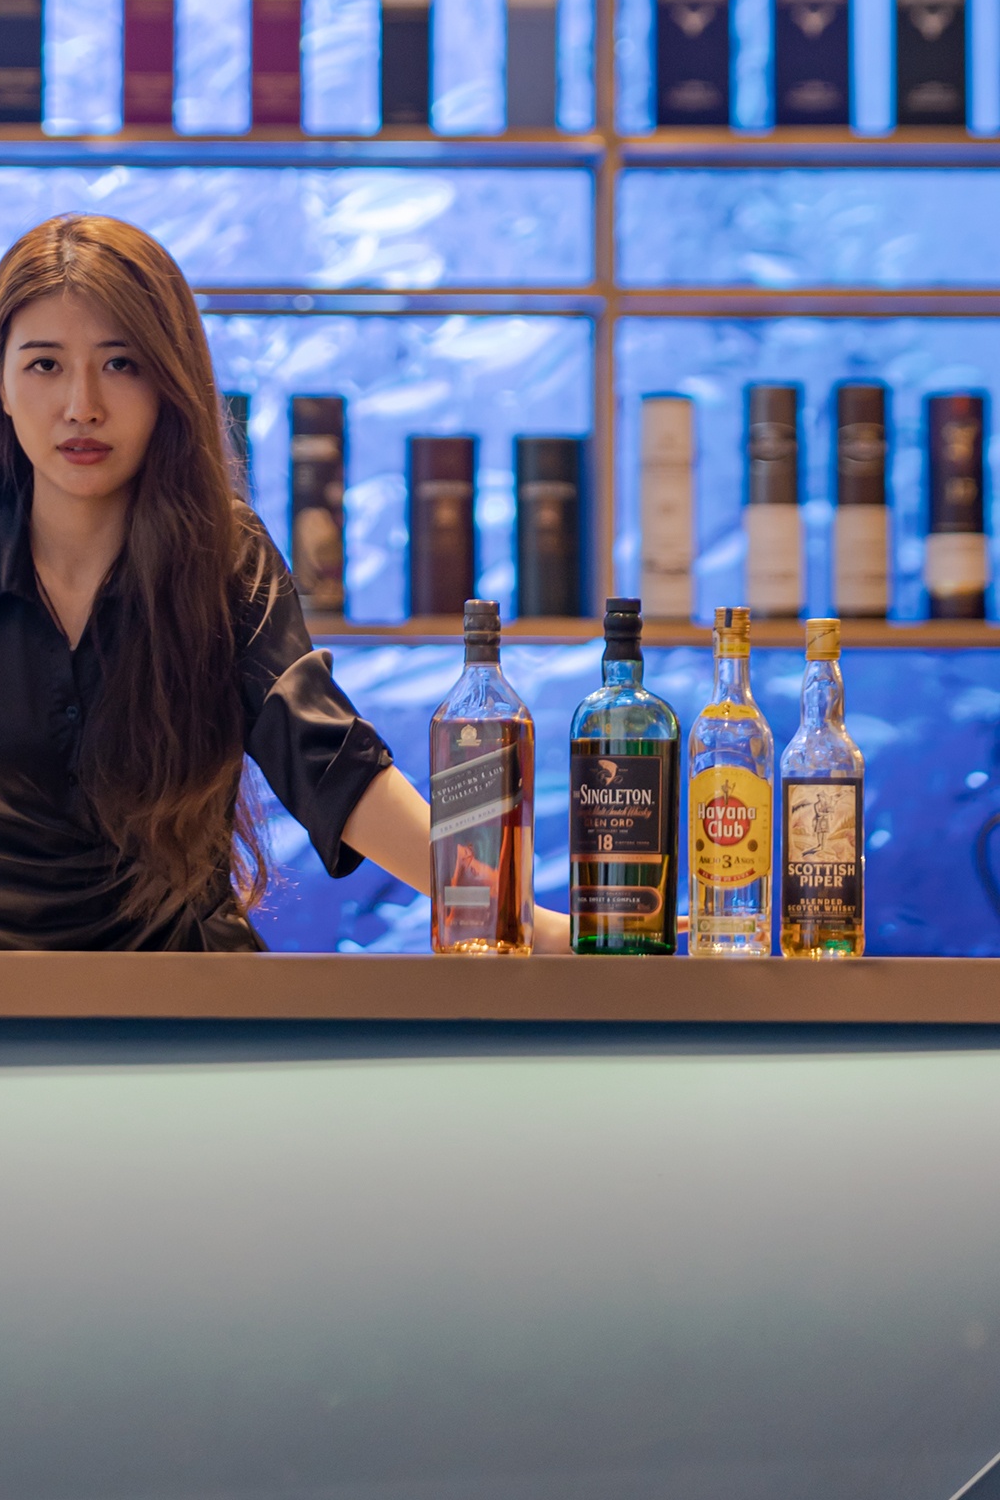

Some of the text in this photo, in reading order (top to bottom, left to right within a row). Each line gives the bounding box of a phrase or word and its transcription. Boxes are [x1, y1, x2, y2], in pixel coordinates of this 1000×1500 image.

[580, 784, 652, 805] SINGLETON
[697, 802, 757, 820] Havana
[610, 818, 634, 828] ORD
[707, 820, 744, 838] Club
[597, 833, 613, 851] 18
[722, 854, 733, 869] 3
[788, 863, 856, 876] SCOTTISH
[800, 875, 843, 887] PIPER
[787, 904, 820, 912] SCOTCH
